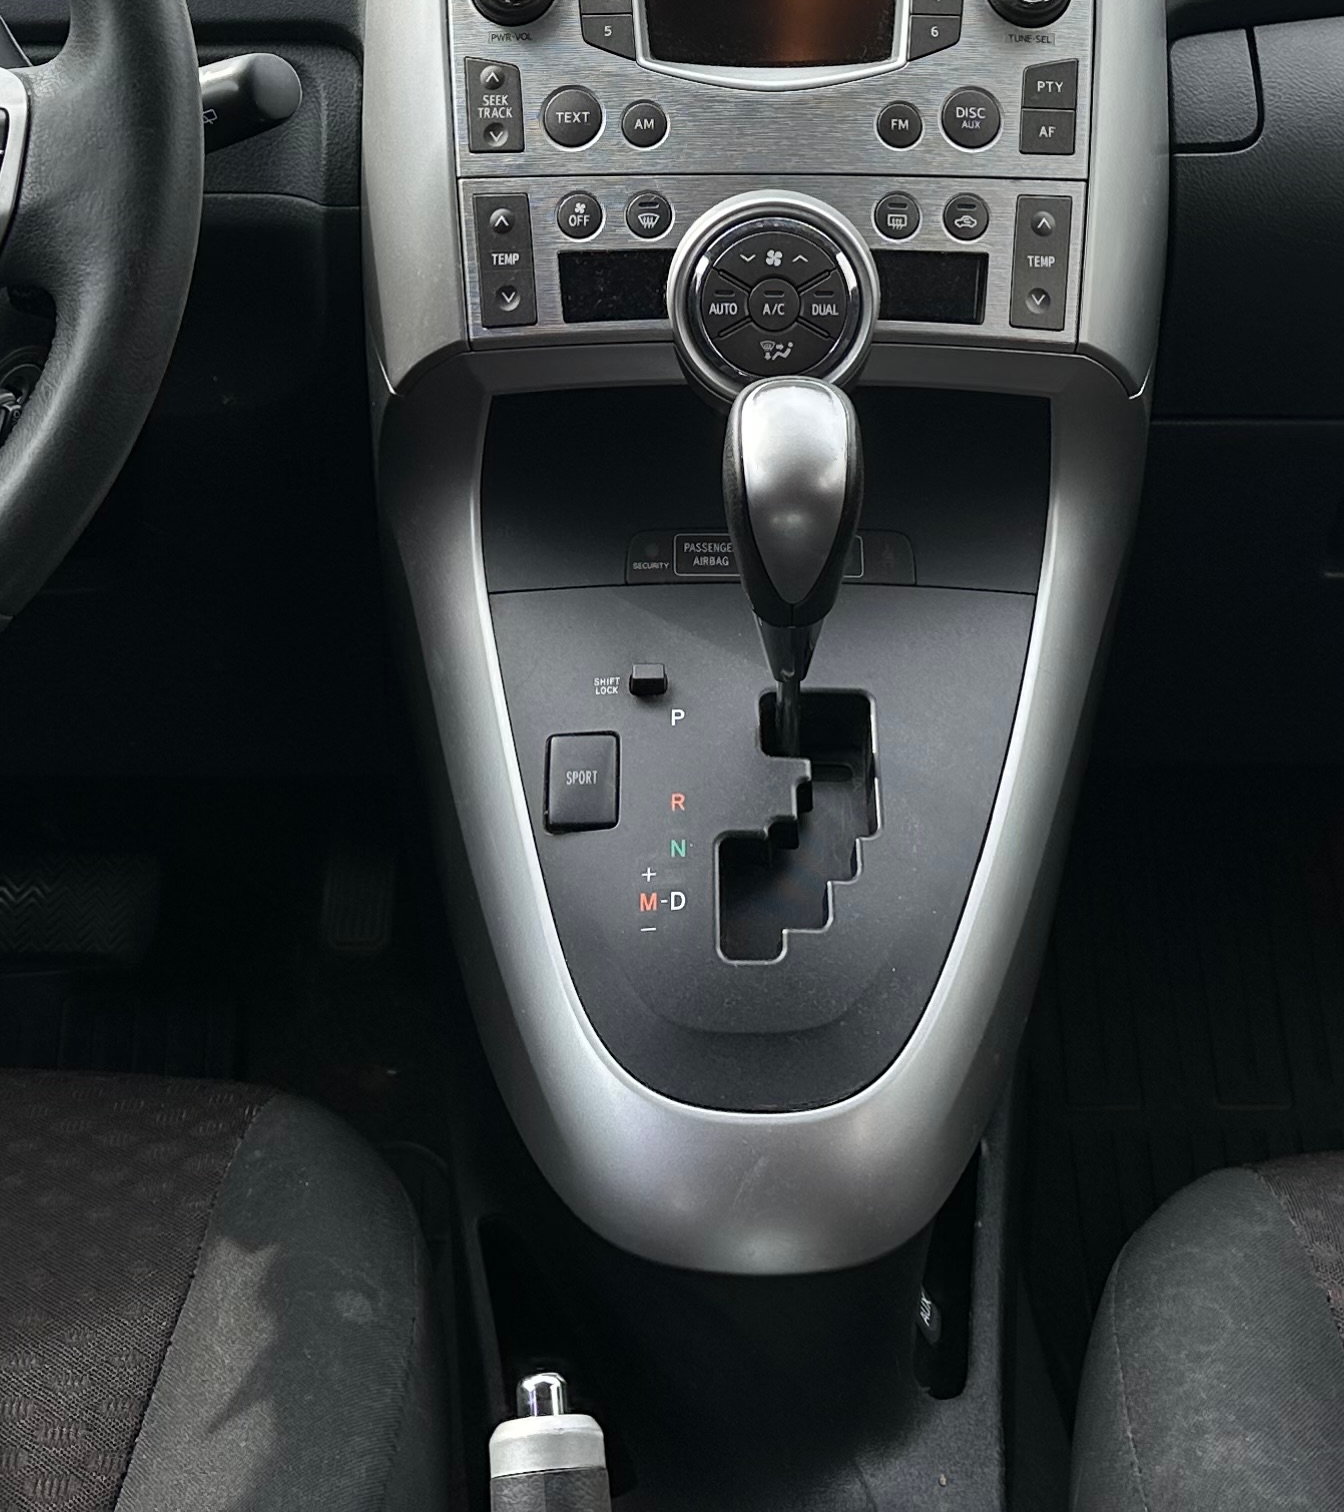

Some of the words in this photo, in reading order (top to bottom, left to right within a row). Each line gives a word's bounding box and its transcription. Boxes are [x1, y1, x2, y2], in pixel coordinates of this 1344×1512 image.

[604, 26, 612, 37] 5
[930, 26, 939, 37] 6
[1037, 81, 1064, 93] PTY
[482, 94, 509, 107] SEEK
[478, 106, 513, 119] TRACK
[556, 111, 590, 124] TEXT
[956, 106, 986, 120] DISC
[634, 118, 655, 130] AM
[891, 118, 909, 130] FM
[961, 120, 981, 129] AUX
[1039, 126, 1056, 138] AF
[568, 215, 590, 227] OFF
[491, 252, 520, 266] TEMP
[1027, 255, 1056, 268] TEMP
[709, 302, 738, 315] AUTO
[762, 303, 785, 315] A/C
[811, 303, 839, 316] DUAL
[683, 542, 734, 554] PASSENGE
[632, 561, 670, 570] SECURITY
[692, 555, 730, 567] AIRBAG
[594, 677, 621, 686] SHIFT
[595, 686, 619, 695] LOCK
[671, 709, 685, 726] P
[566, 770, 598, 785] SPORT
[671, 793, 686, 811] R
[670, 840, 686, 858] N
